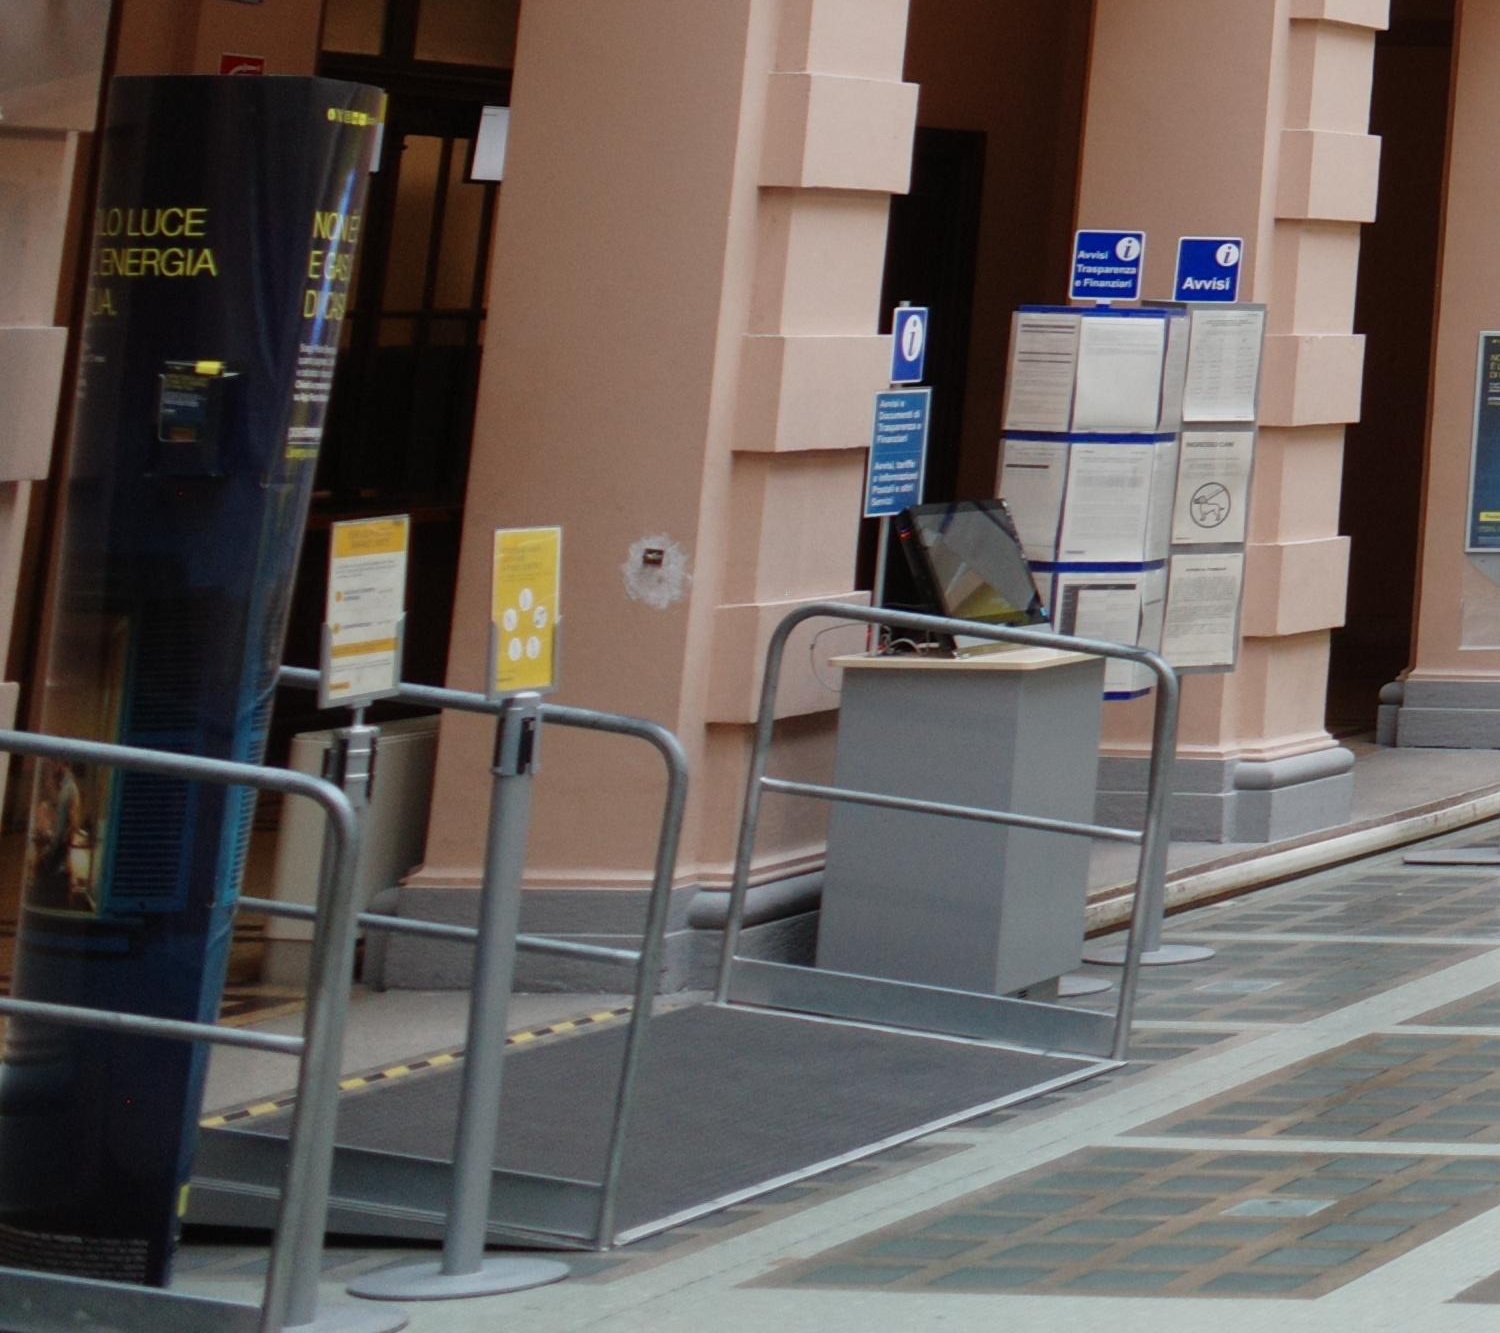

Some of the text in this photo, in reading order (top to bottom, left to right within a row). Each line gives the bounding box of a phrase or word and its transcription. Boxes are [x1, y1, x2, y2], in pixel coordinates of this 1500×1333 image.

[127, 208, 208, 237] LUCE
[1077, 250, 1109, 260] Avvisi
[1077, 264, 1137, 276] Trasparenza
[1074, 278, 1133, 289] e Finanziari
[1181, 277, 1231, 291] Avvisi
